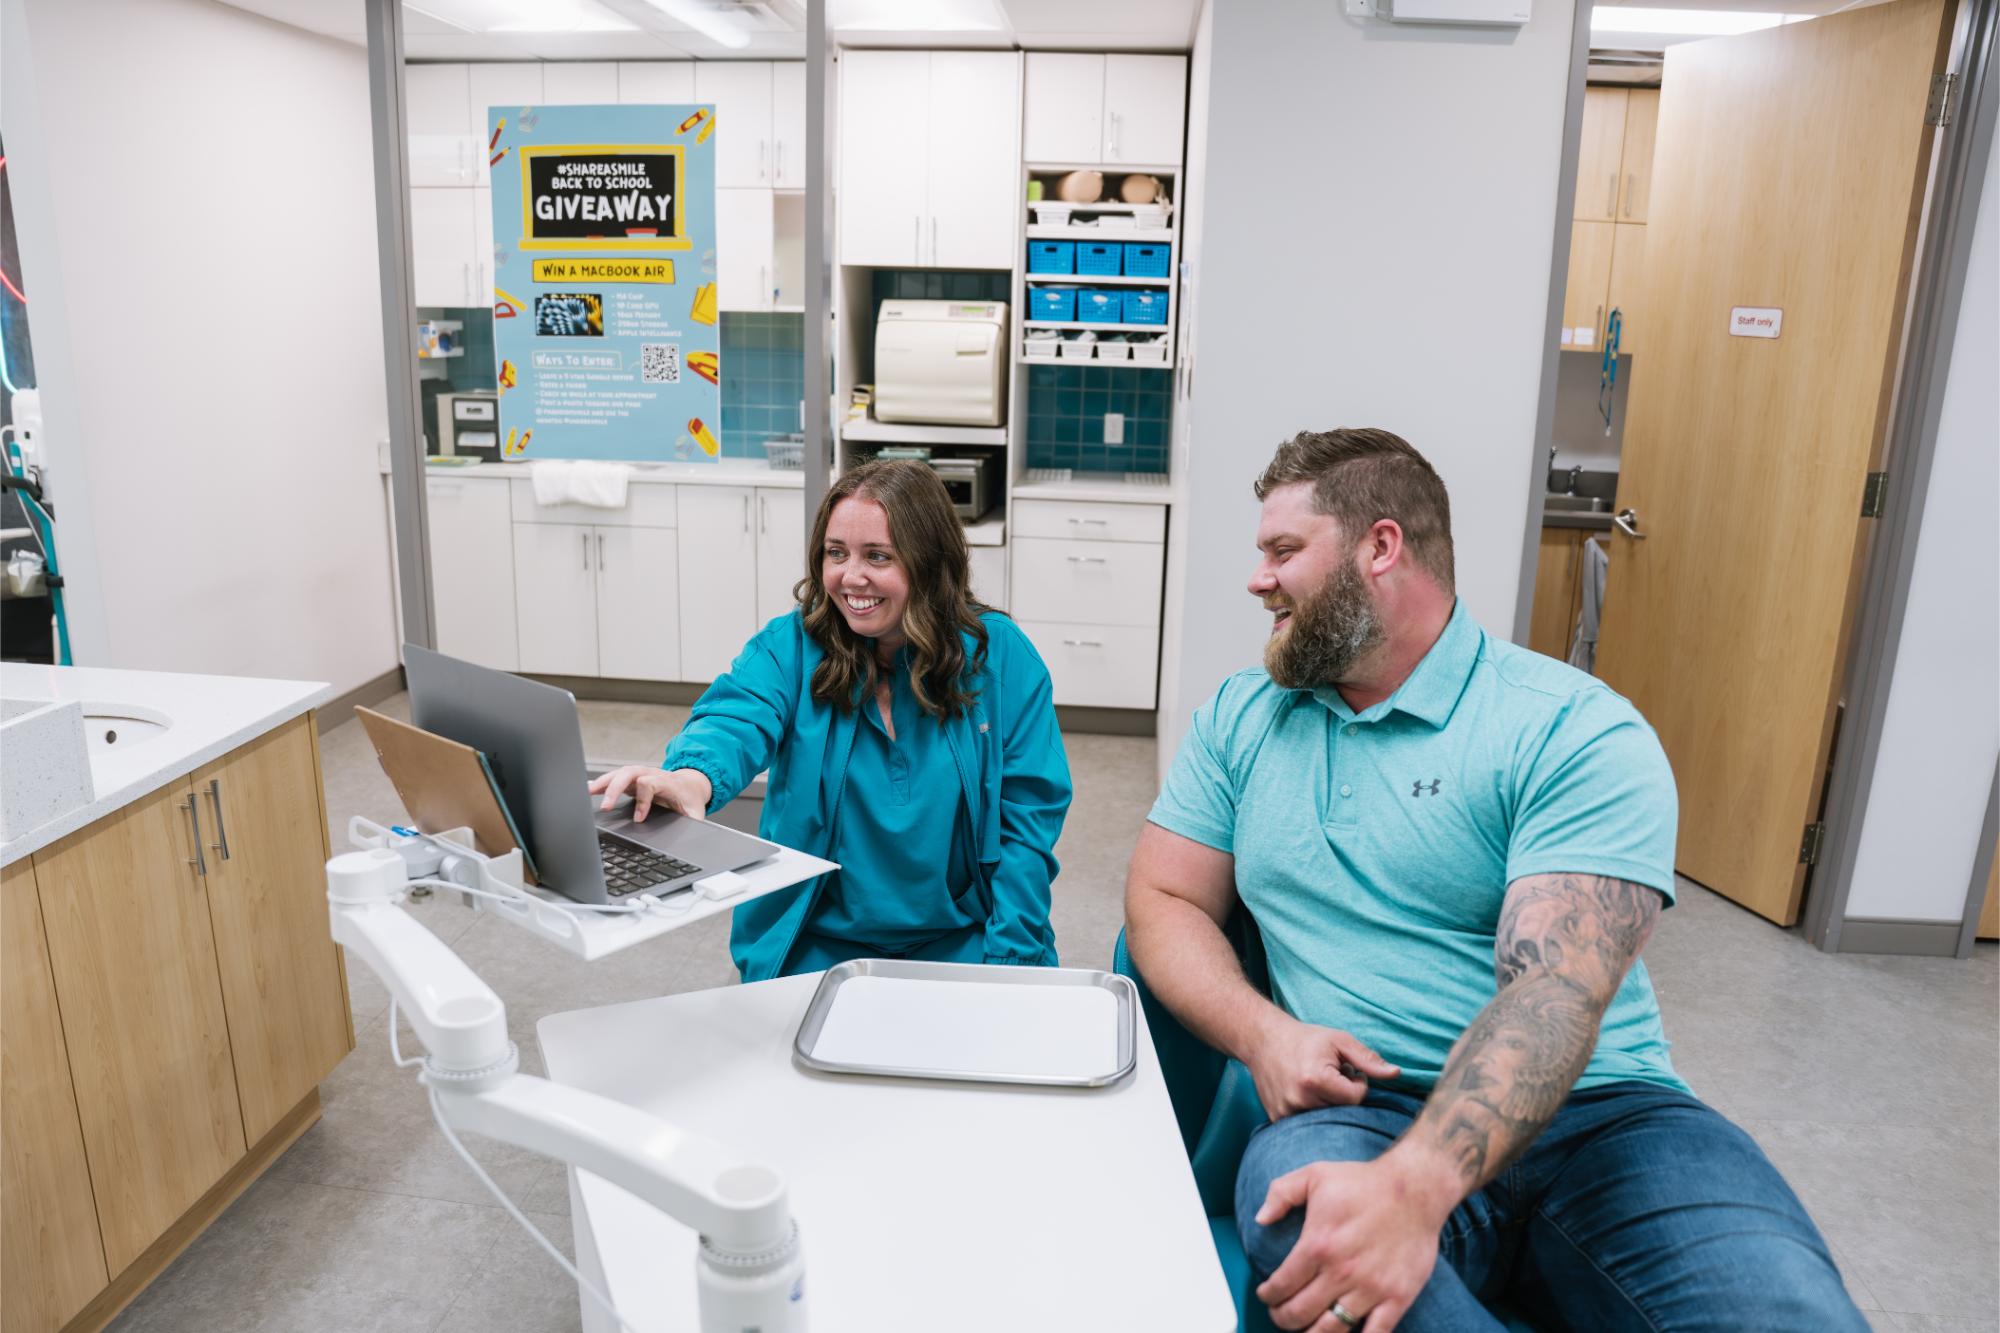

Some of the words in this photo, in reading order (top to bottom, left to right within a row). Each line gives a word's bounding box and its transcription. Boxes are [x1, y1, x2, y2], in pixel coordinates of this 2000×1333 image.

[557, 163, 646, 176] #SHAREASMILE
[551, 177, 583, 190] BACK
[585, 177, 603, 189] TO
[605, 177, 653, 190] SCHOOL
[535, 189, 672, 222] GIVEAWAY
[542, 262, 566, 277] WIN
[569, 265, 577, 276] A
[581, 265, 641, 277] MACBOOK
[644, 265, 665, 277] AIR
[565, 354, 580, 366] TO
